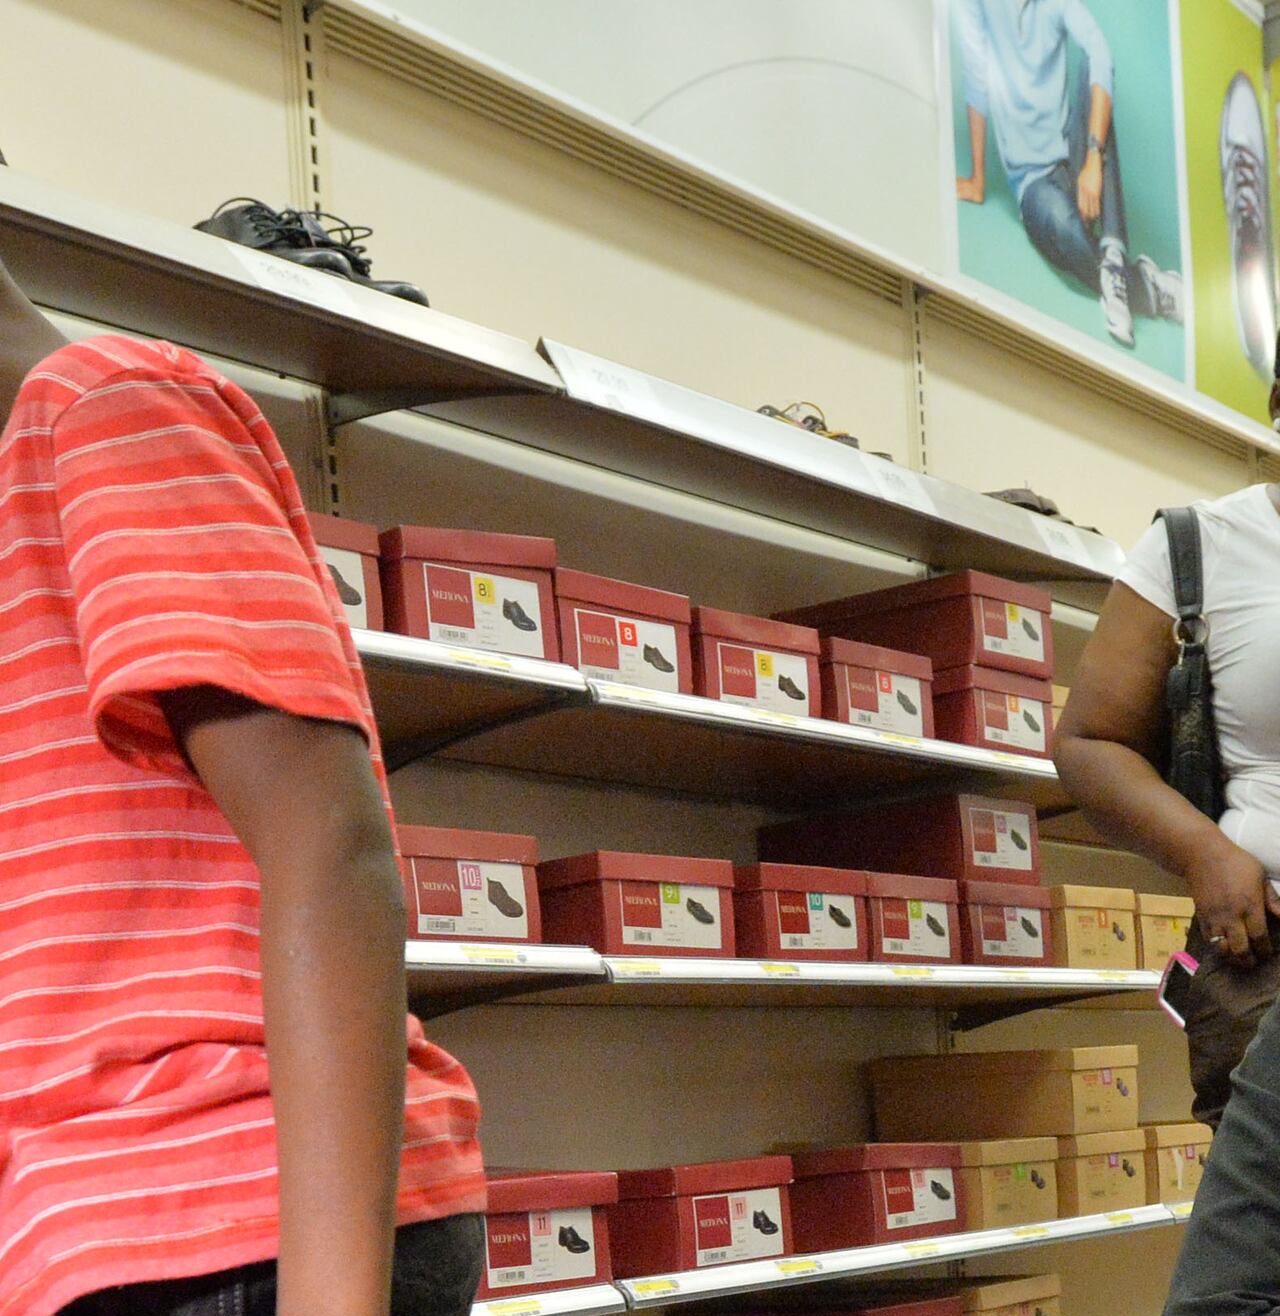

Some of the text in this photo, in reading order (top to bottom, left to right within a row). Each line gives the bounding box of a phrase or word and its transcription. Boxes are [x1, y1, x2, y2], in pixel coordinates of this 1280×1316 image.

[431, 589, 468, 604] MERONA
[624, 627, 634, 641] 8
[536, 1215, 546, 1231] 11
[491, 1233, 527, 1244] MERONA
